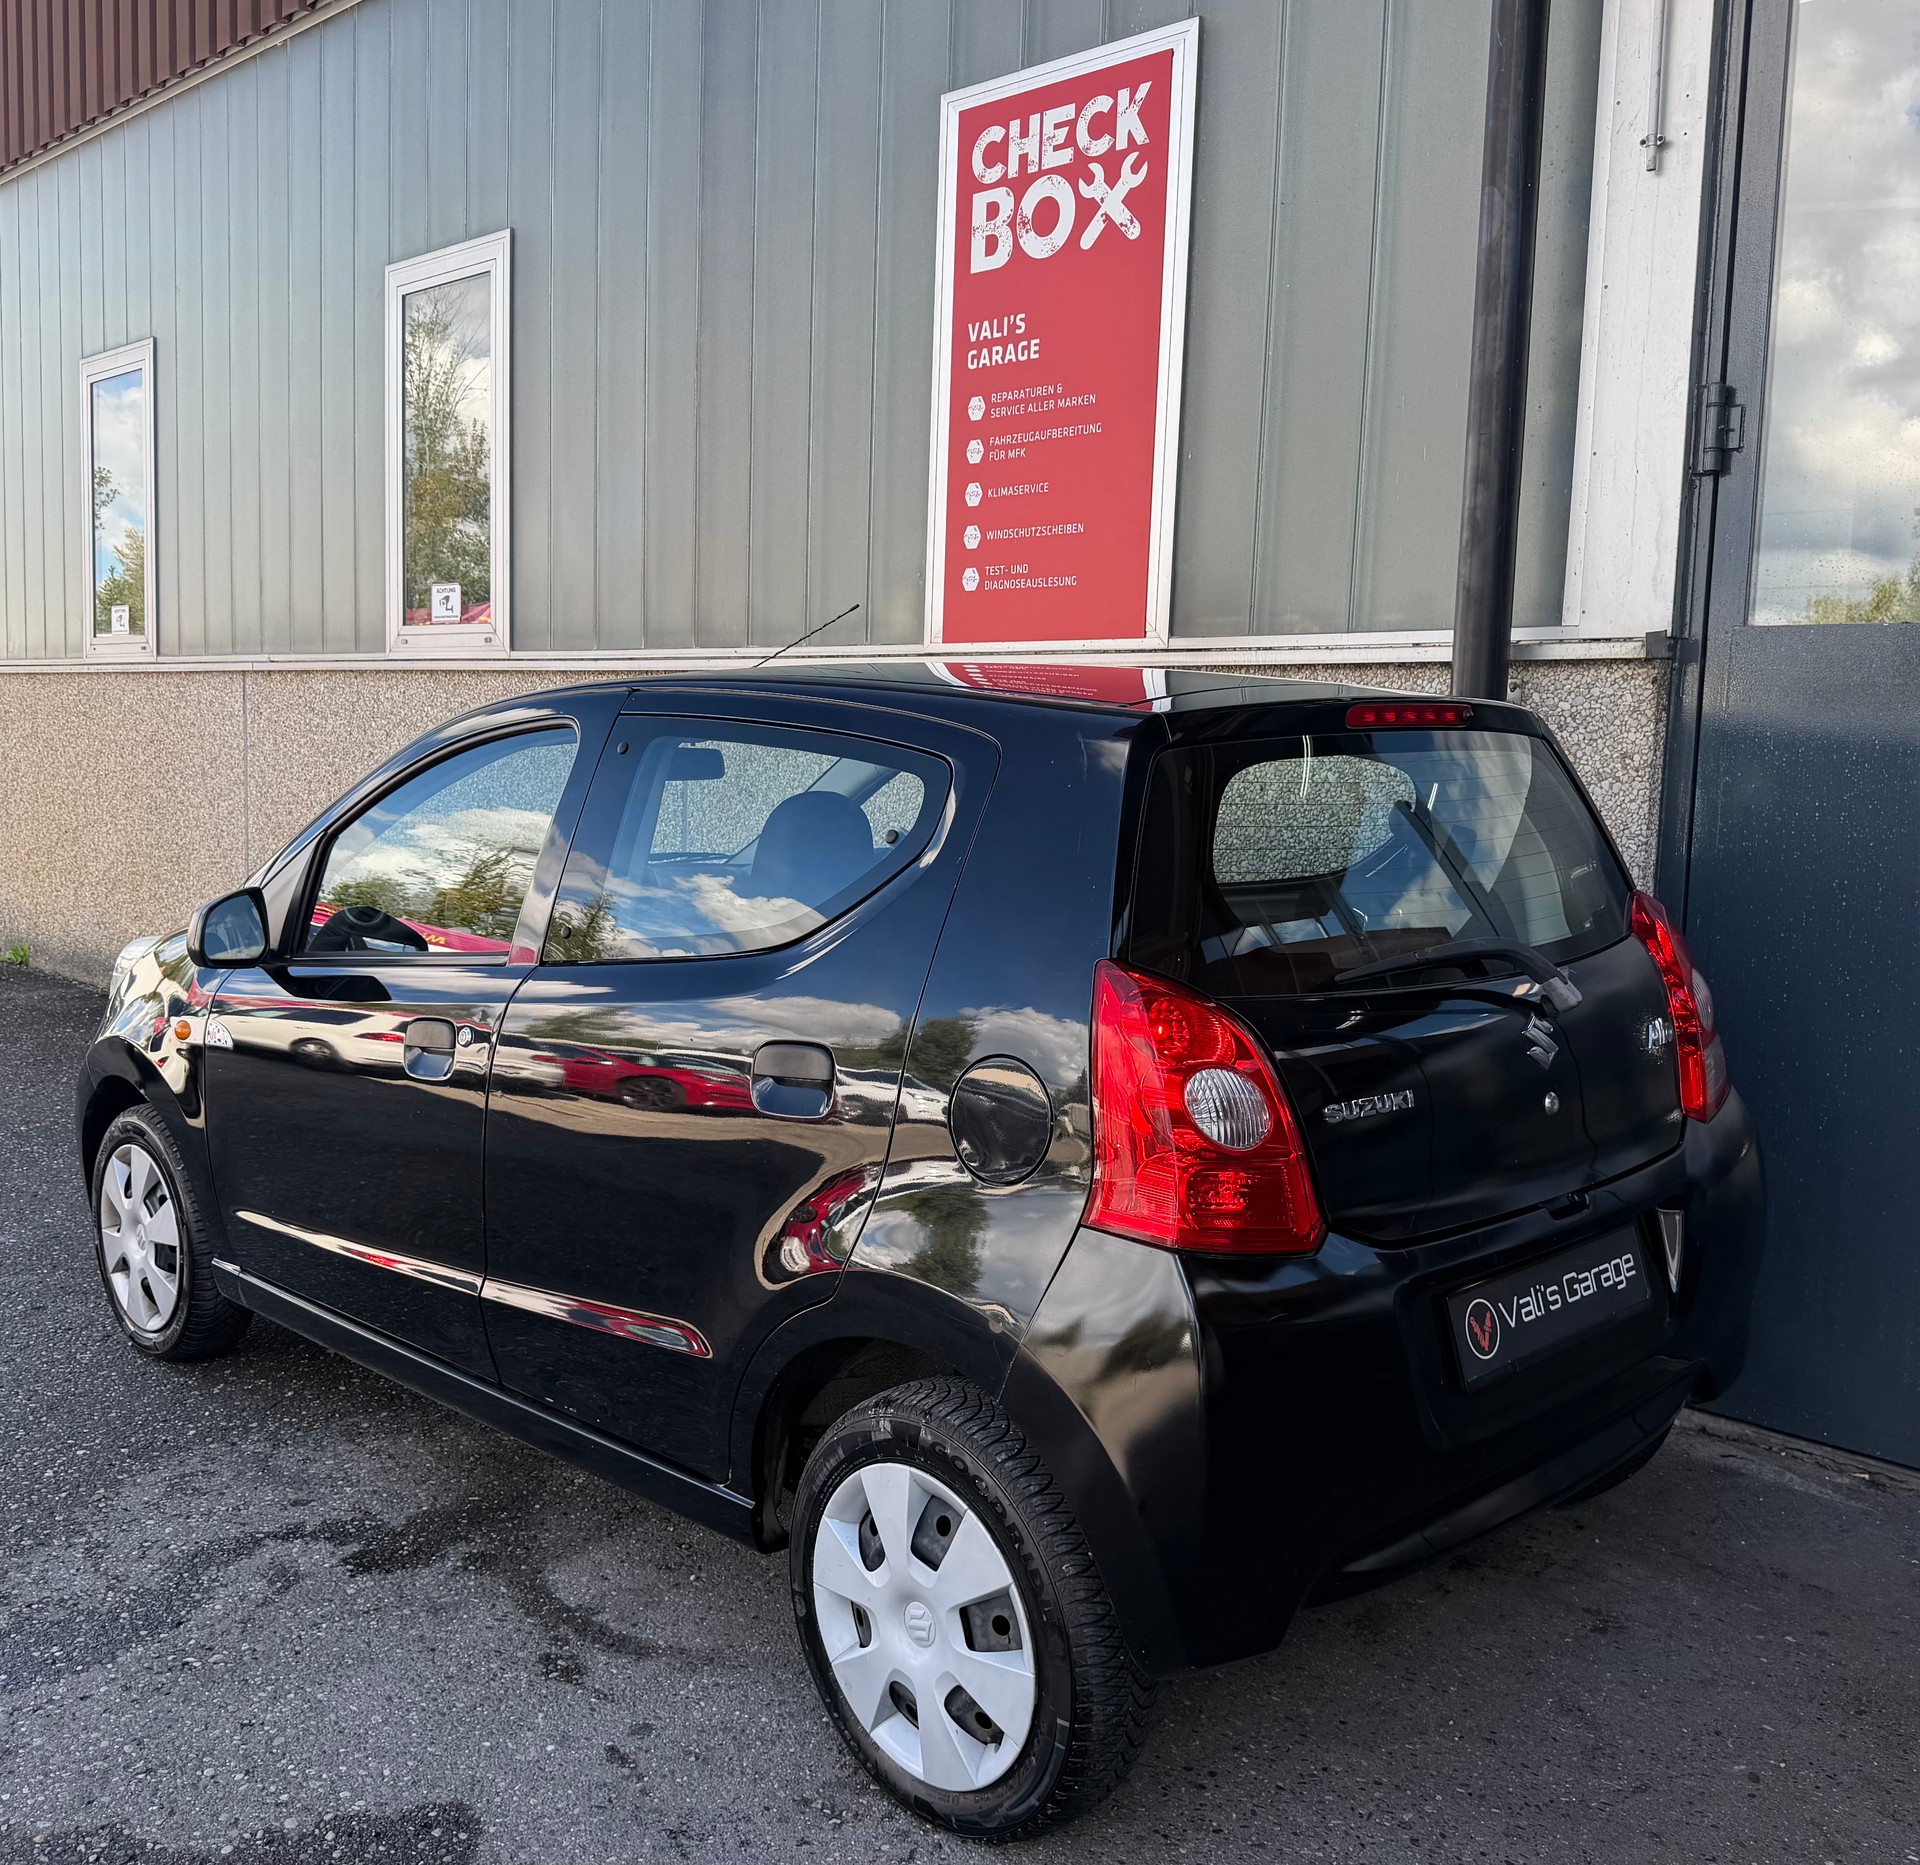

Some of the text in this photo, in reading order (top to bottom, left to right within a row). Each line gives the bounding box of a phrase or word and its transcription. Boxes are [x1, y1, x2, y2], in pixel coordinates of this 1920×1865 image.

[972, 81, 1152, 184] CHECK
[968, 313, 1026, 342] VALI'S
[967, 338, 1040, 370] GARAGE
[991, 383, 1063, 404] REPARATUREN &
[990, 393, 1096, 419] SERVICE ALLER MARKEN
[989, 422, 1102, 446] FAHRZEUGAUFBEREITUNG
[989, 448, 1026, 462] FÜR MFK
[987, 482, 1049, 498] KLIMASERVICE
[986, 523, 1084, 540] WINDSCHUTZSCHEIBEN
[984, 564, 1029, 576] TEST- UND
[984, 576, 1077, 590] DIAGNOSEAUSLESUNG
[1322, 1090, 1415, 1123] SUZUKI
[1498, 1284, 1562, 1328] Vali's
[1562, 1253, 1636, 1303] Garage
